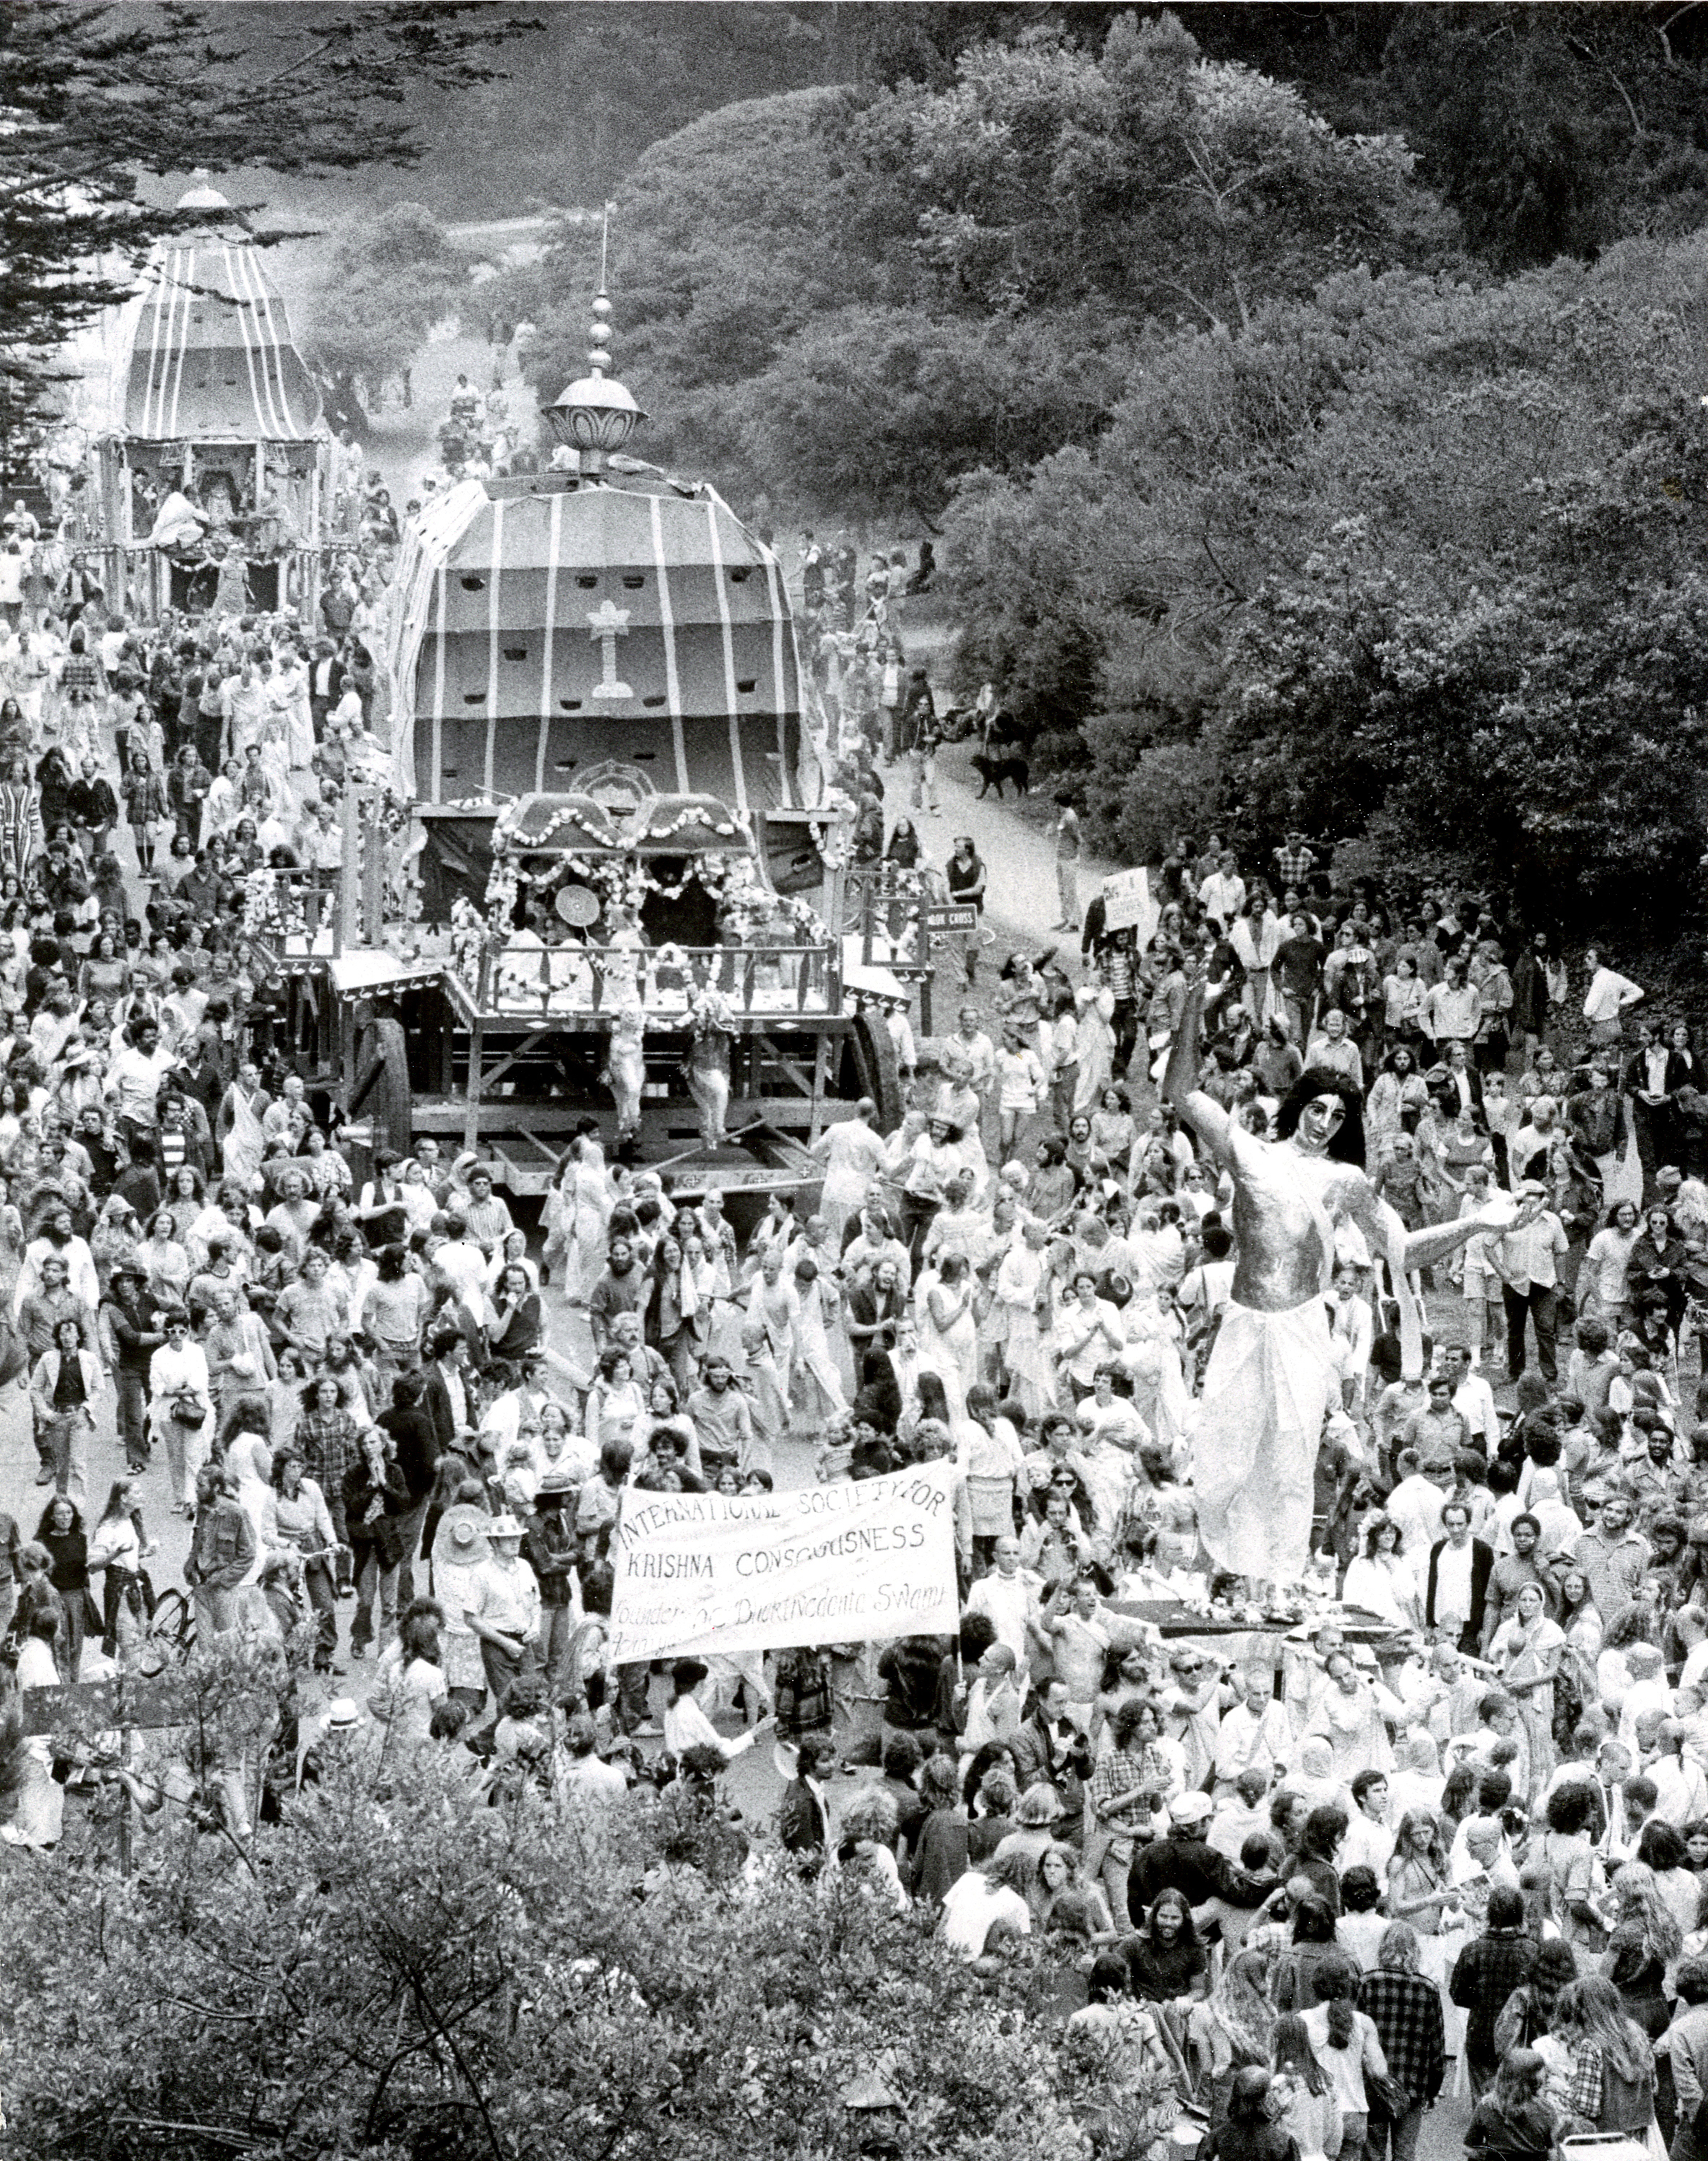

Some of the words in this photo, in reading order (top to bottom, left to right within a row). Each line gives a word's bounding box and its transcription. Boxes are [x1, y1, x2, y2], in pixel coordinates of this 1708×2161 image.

[949, 912, 974, 925] CROSS
[618, 1498, 780, 1550] INTERNATIONAL
[797, 1480, 904, 1514] SOCIETY
[900, 1480, 946, 1517] FOR
[628, 1553, 714, 1579] KRISHNA
[736, 1524, 925, 1576] CONSCOUSNESS
[873, 1581, 945, 1609] Swami
